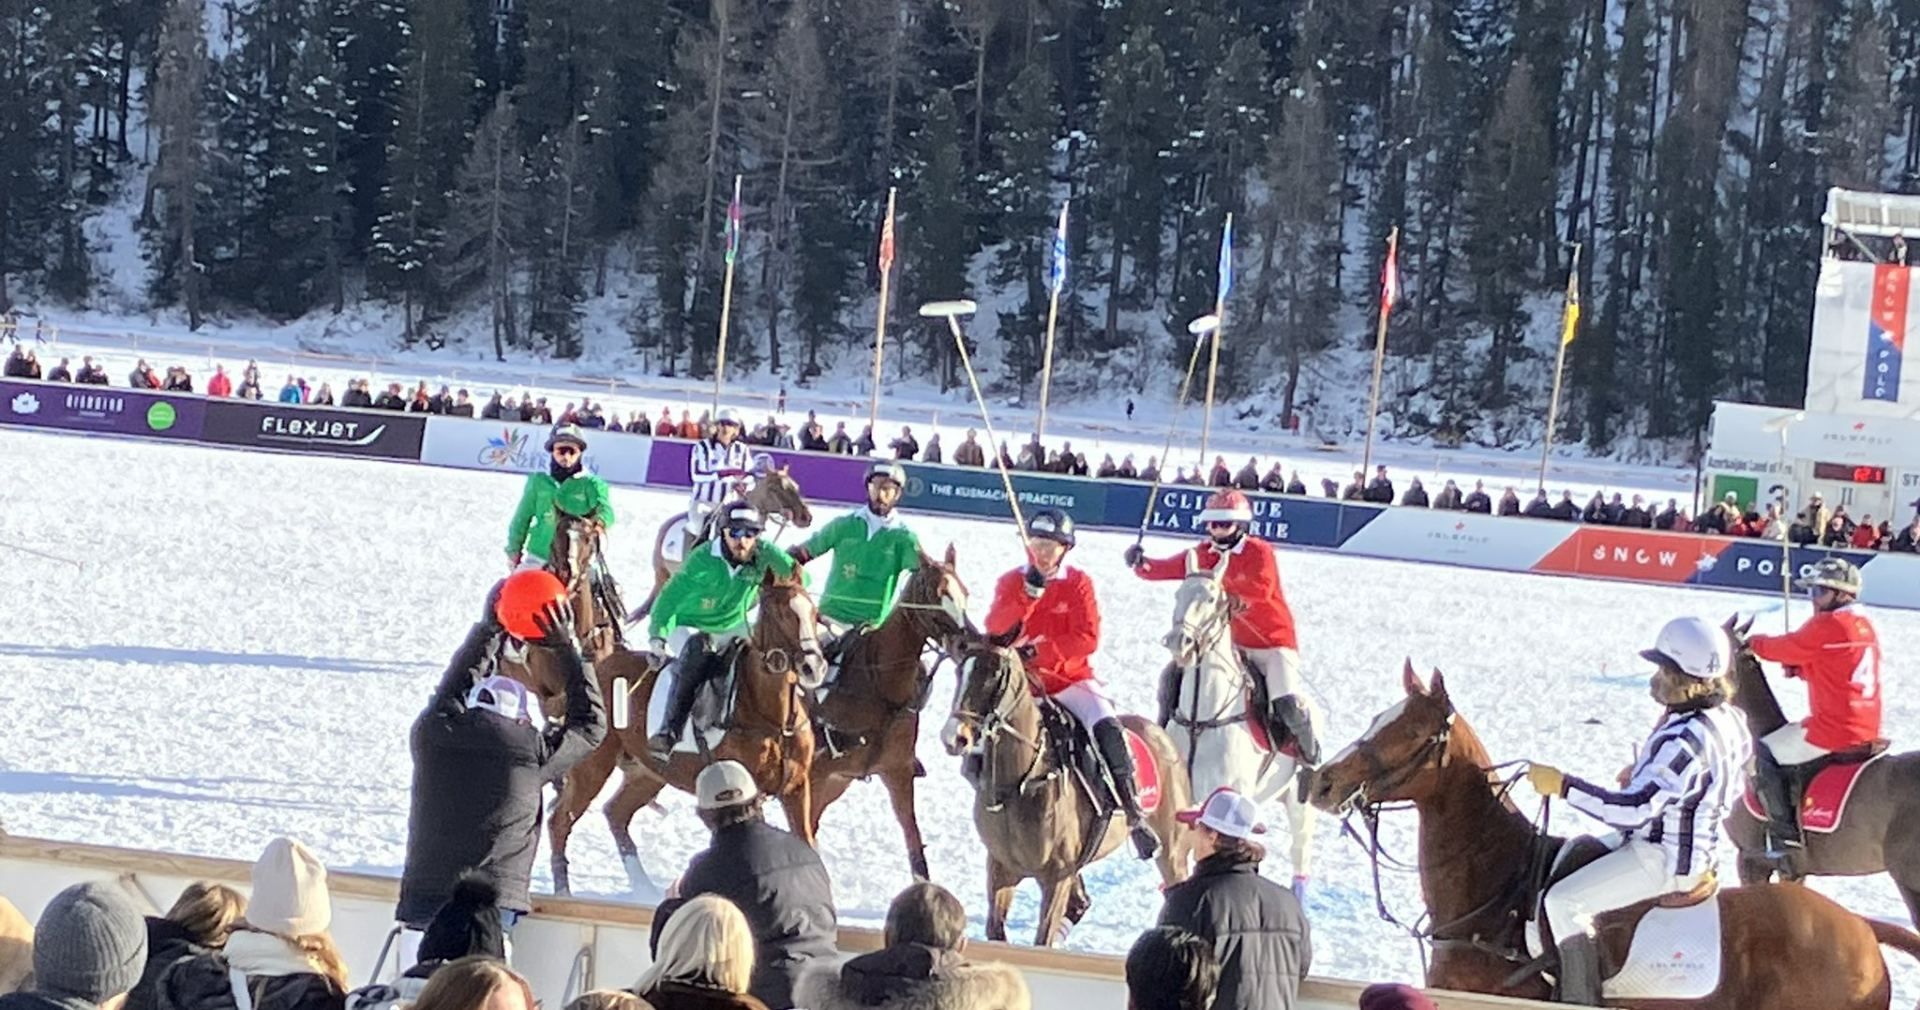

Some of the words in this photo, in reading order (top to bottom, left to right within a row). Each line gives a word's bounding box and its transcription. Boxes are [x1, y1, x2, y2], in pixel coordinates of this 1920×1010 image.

[931, 483, 952, 496] THE
[1018, 491, 1075, 507] PRACTICE
[1163, 493, 1282, 518] CLIUE
[1153, 512, 1180, 529] LA
[1848, 645, 1875, 699] 4
